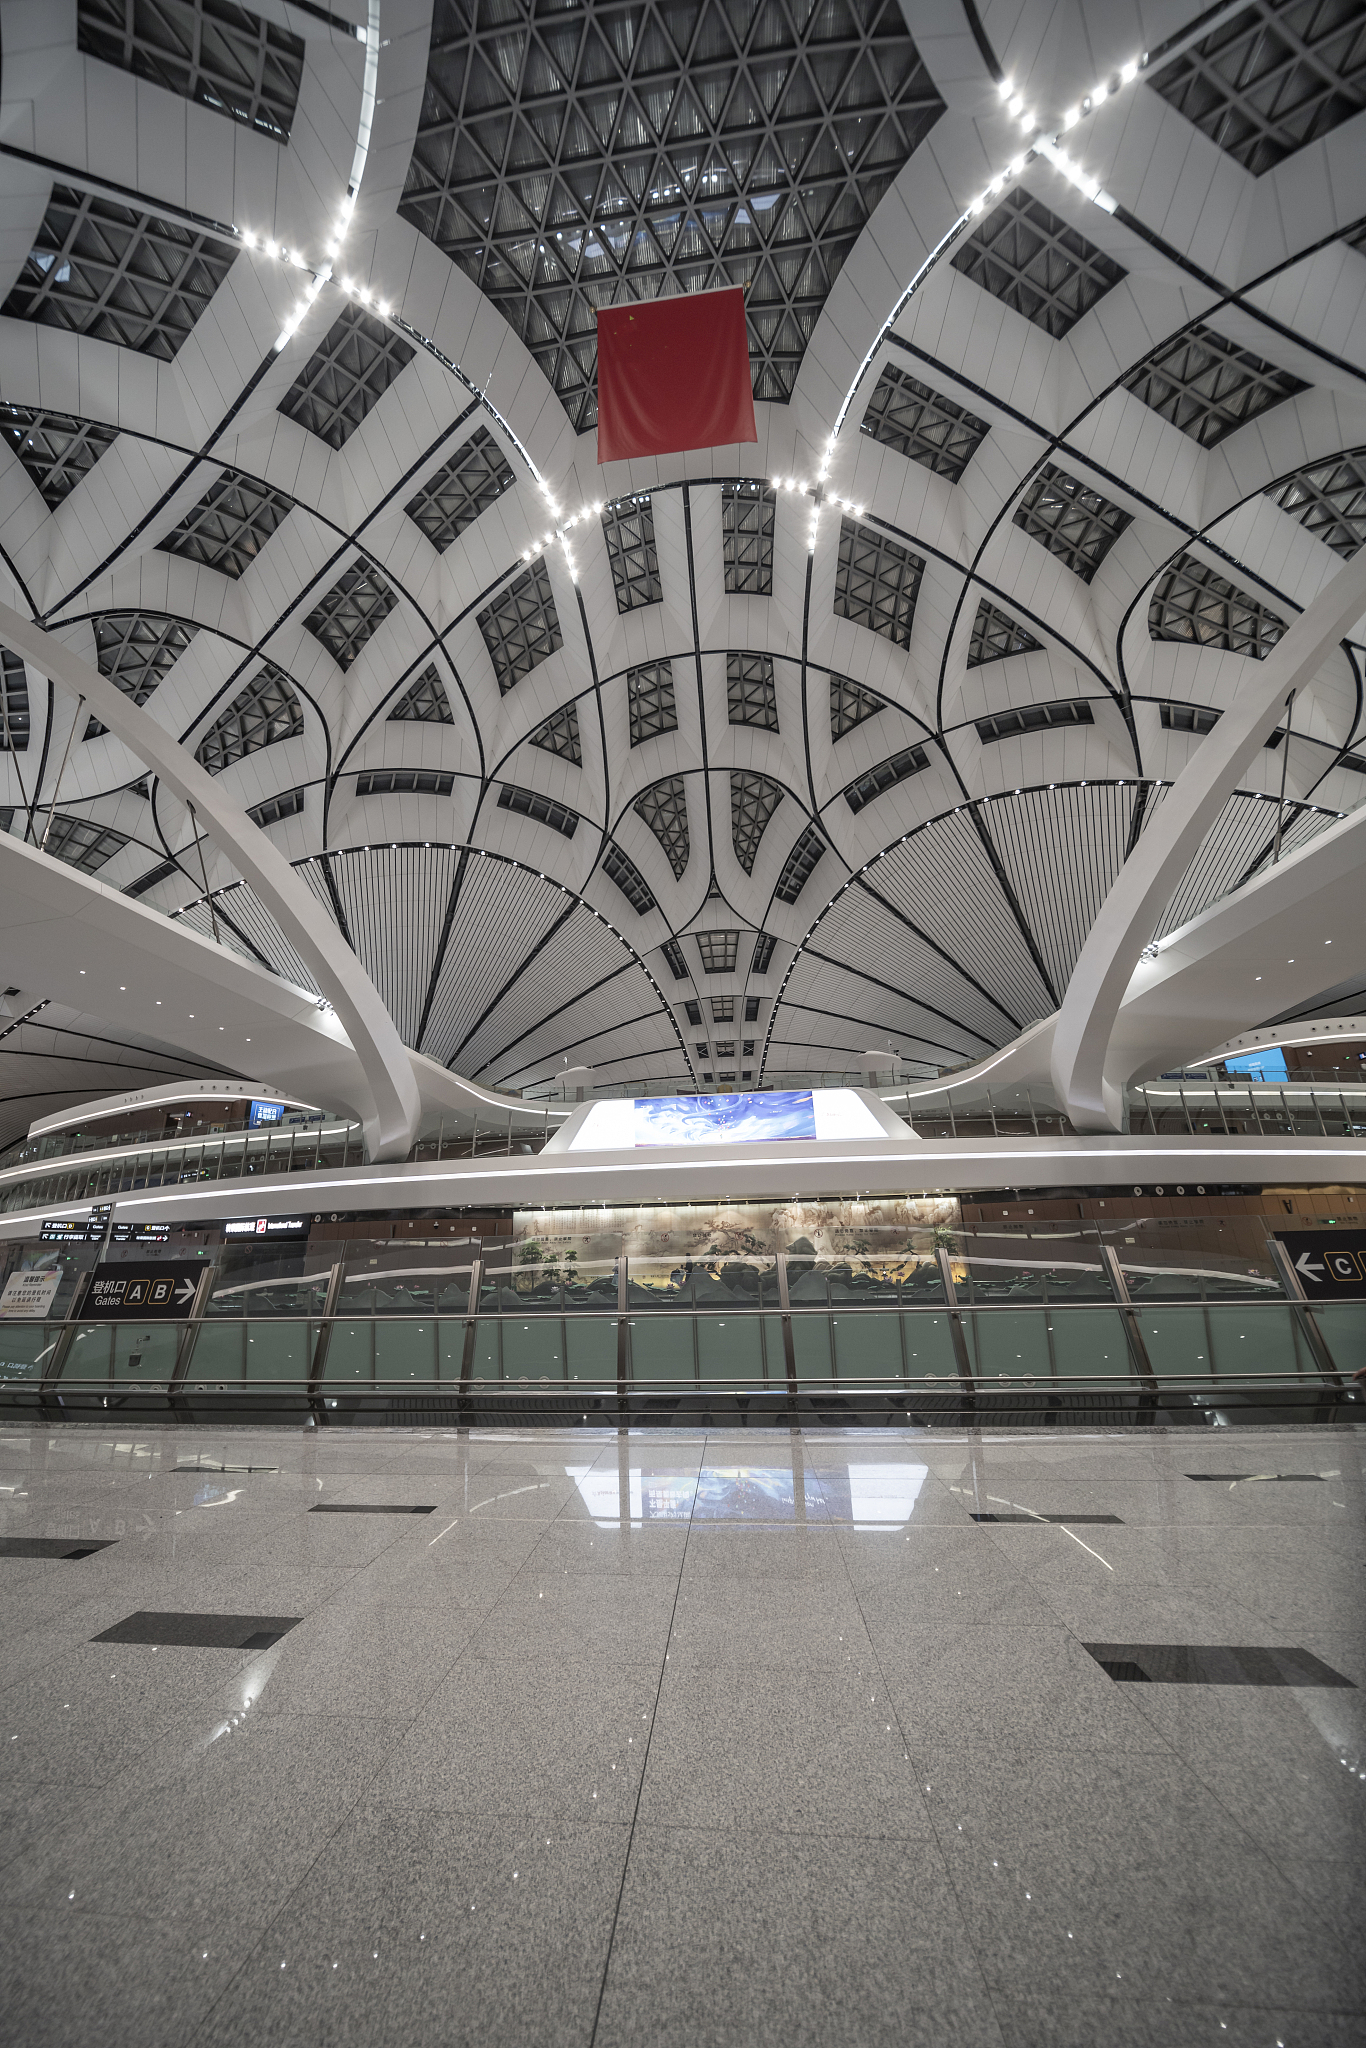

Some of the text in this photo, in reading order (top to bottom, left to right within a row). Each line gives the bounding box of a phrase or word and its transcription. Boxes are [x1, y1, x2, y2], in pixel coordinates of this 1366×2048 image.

[1335, 1258, 1352, 1275] C
[92, 1281, 167, 1300] 登机口 A B
[94, 1295, 121, 1306] Gates
